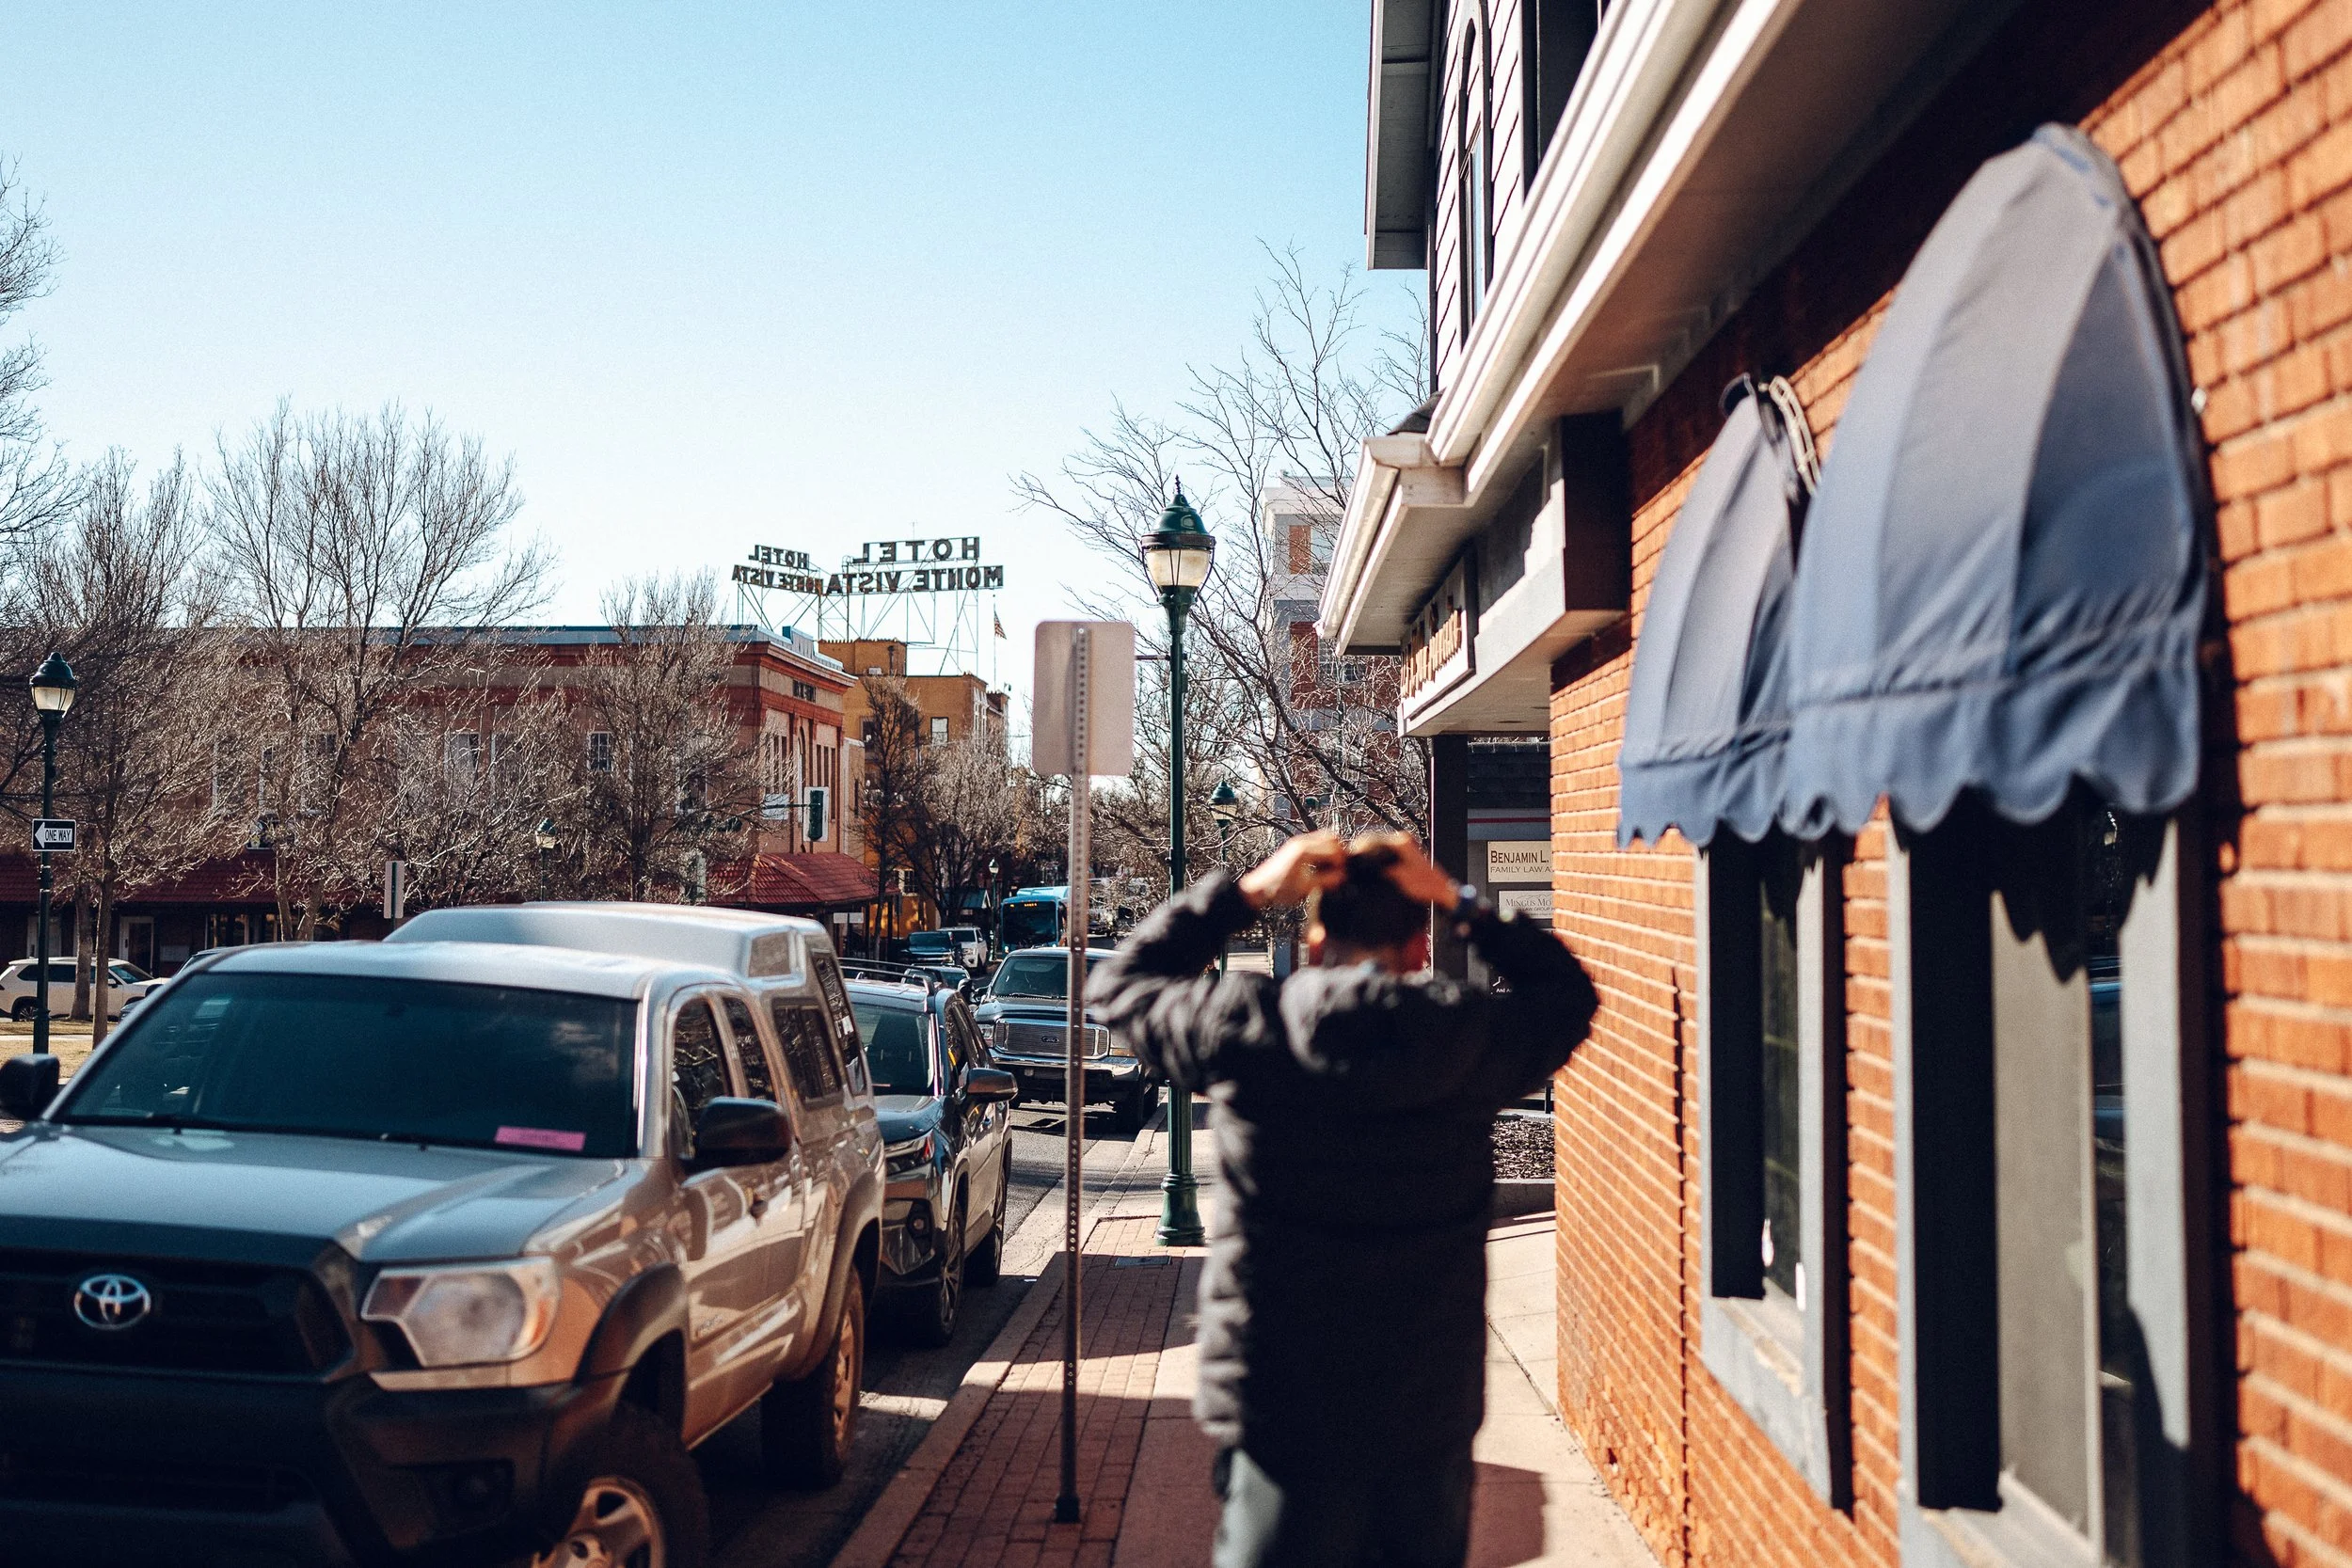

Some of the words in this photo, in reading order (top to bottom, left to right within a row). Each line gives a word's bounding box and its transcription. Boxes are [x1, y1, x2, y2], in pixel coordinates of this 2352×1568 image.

[45, 829, 56, 841] ONE
[58, 829, 71, 841] WAY
[1490, 850, 1538, 863] BENJAMIN
[1540, 849, 1549, 863] L.
[1505, 898, 1536, 907] MINGUS
[1537, 898, 1553, 907] MO
